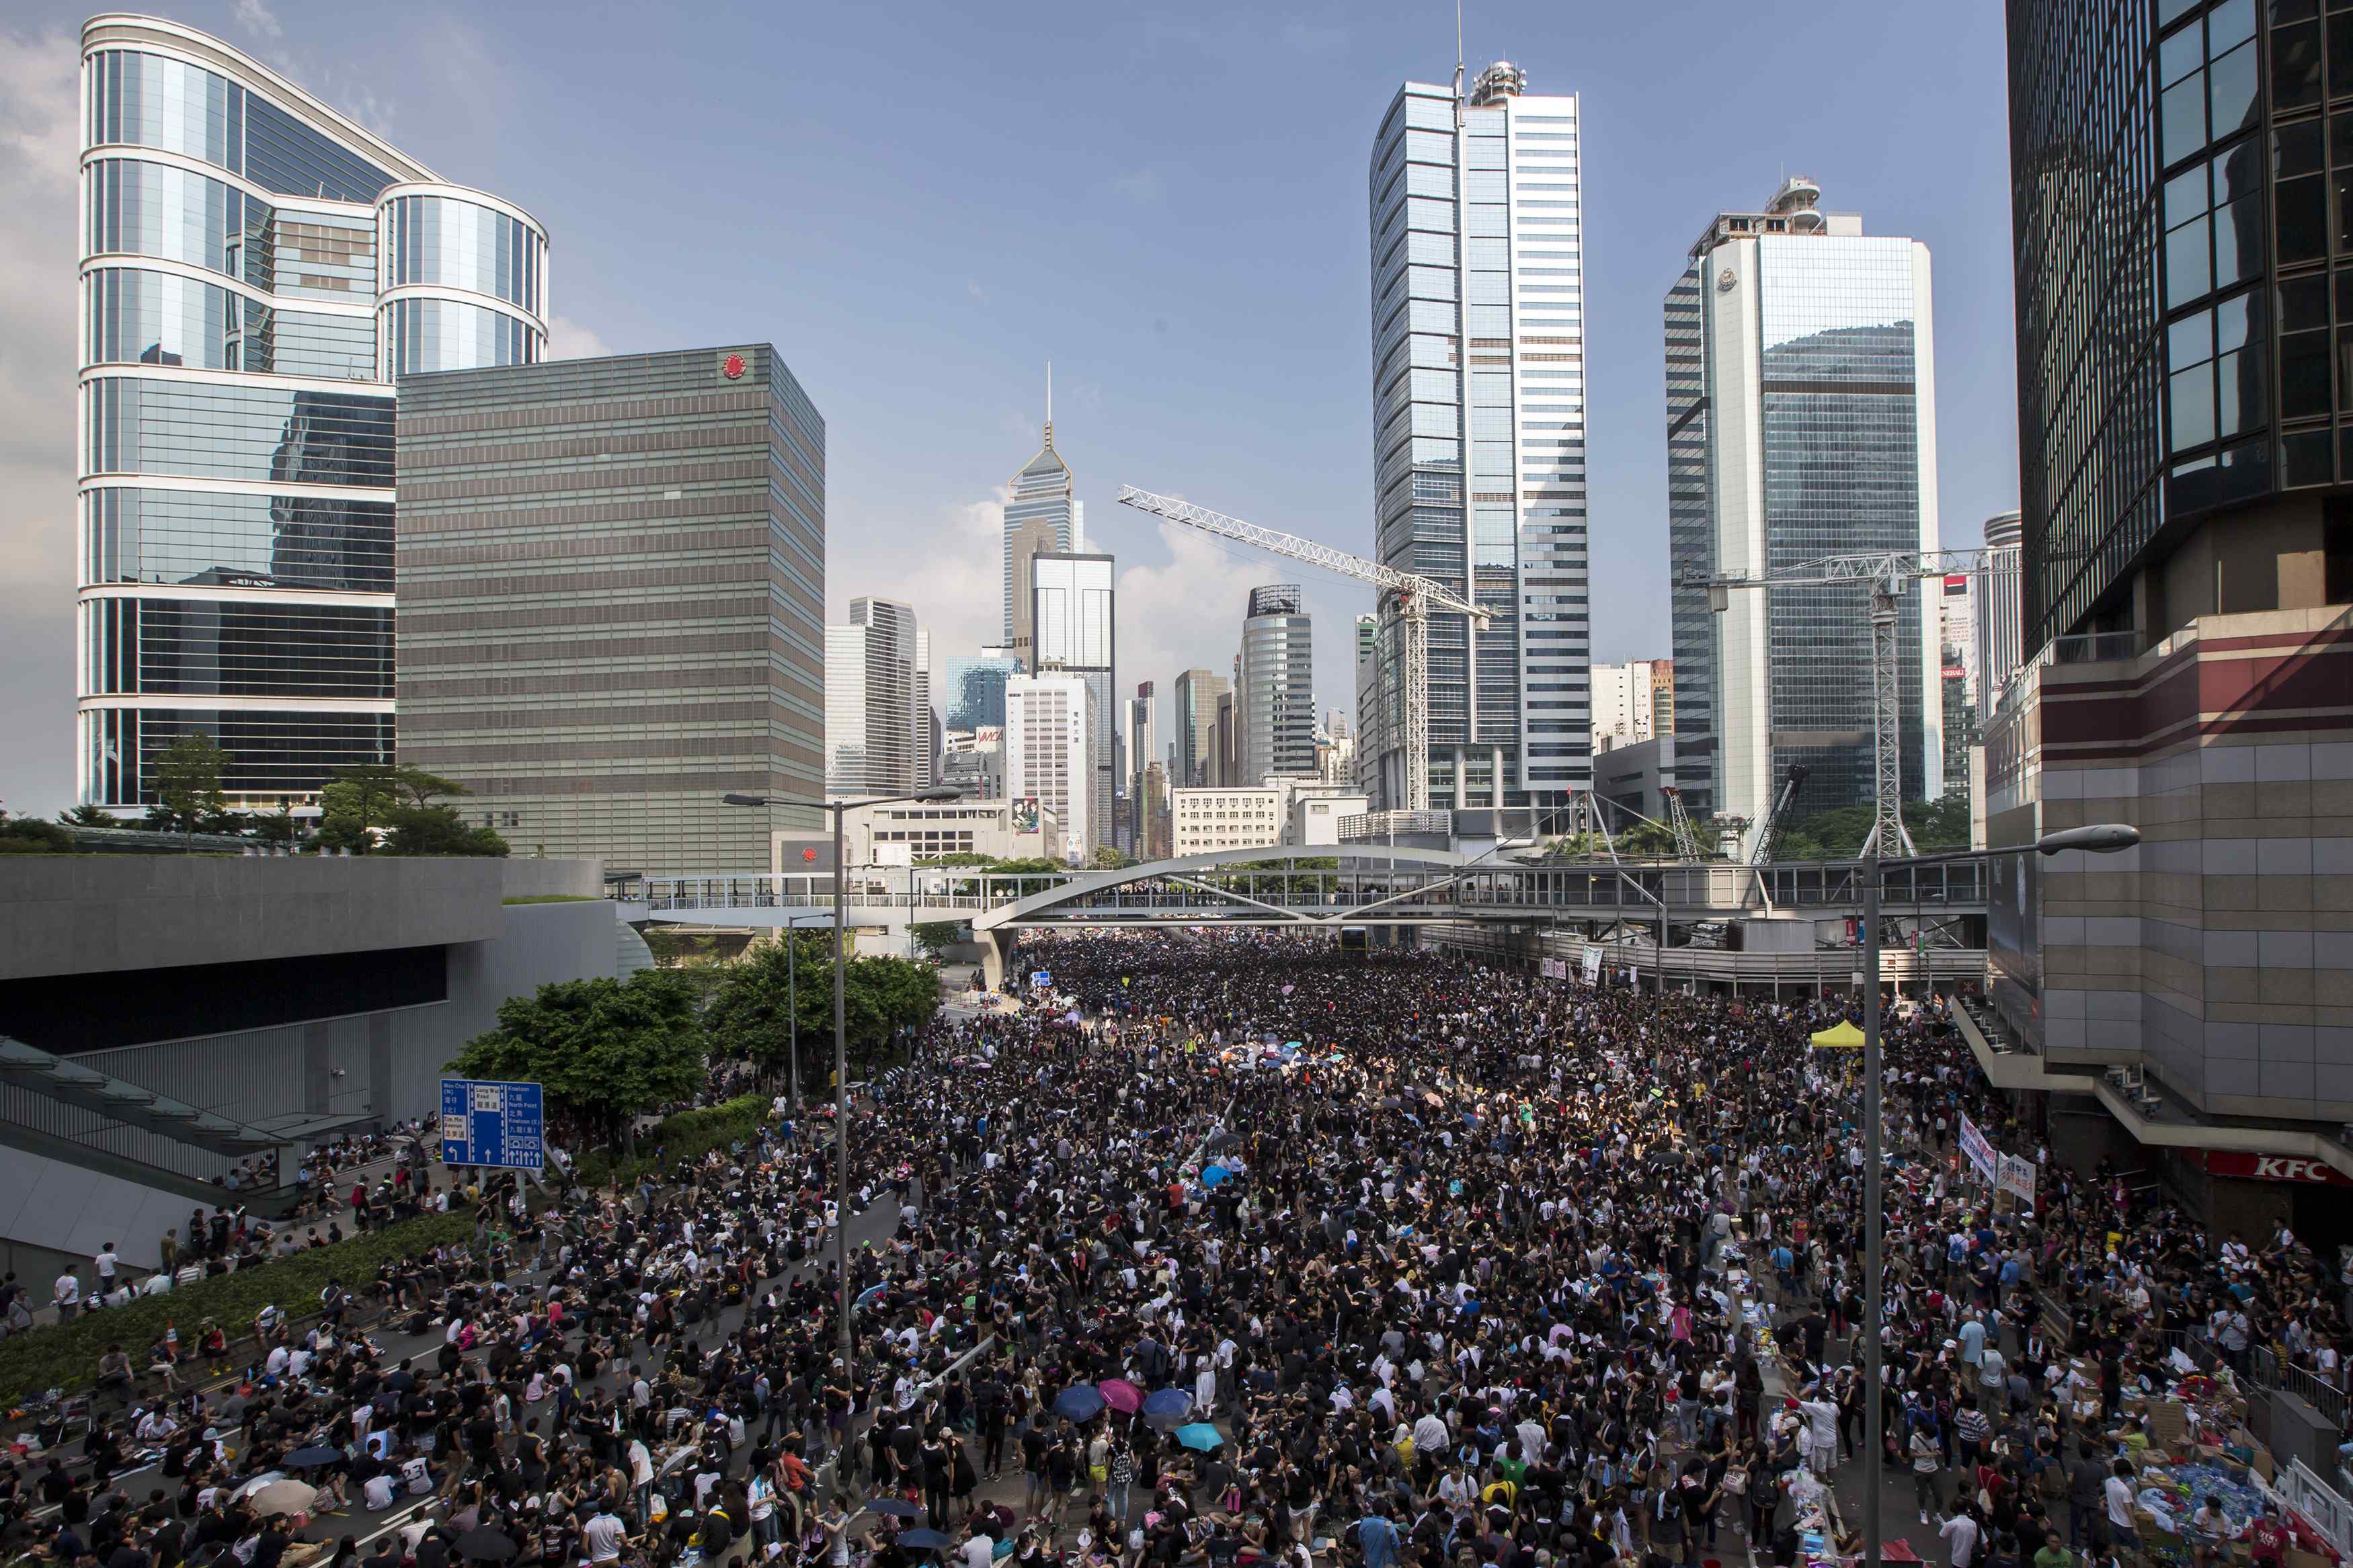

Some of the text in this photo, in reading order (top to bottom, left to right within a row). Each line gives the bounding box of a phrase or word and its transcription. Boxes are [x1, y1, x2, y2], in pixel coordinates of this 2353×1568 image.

[978, 728, 1004, 744] YMCA
[2254, 1157, 2328, 1181] KFC
[404, 1464, 423, 1482] 23
